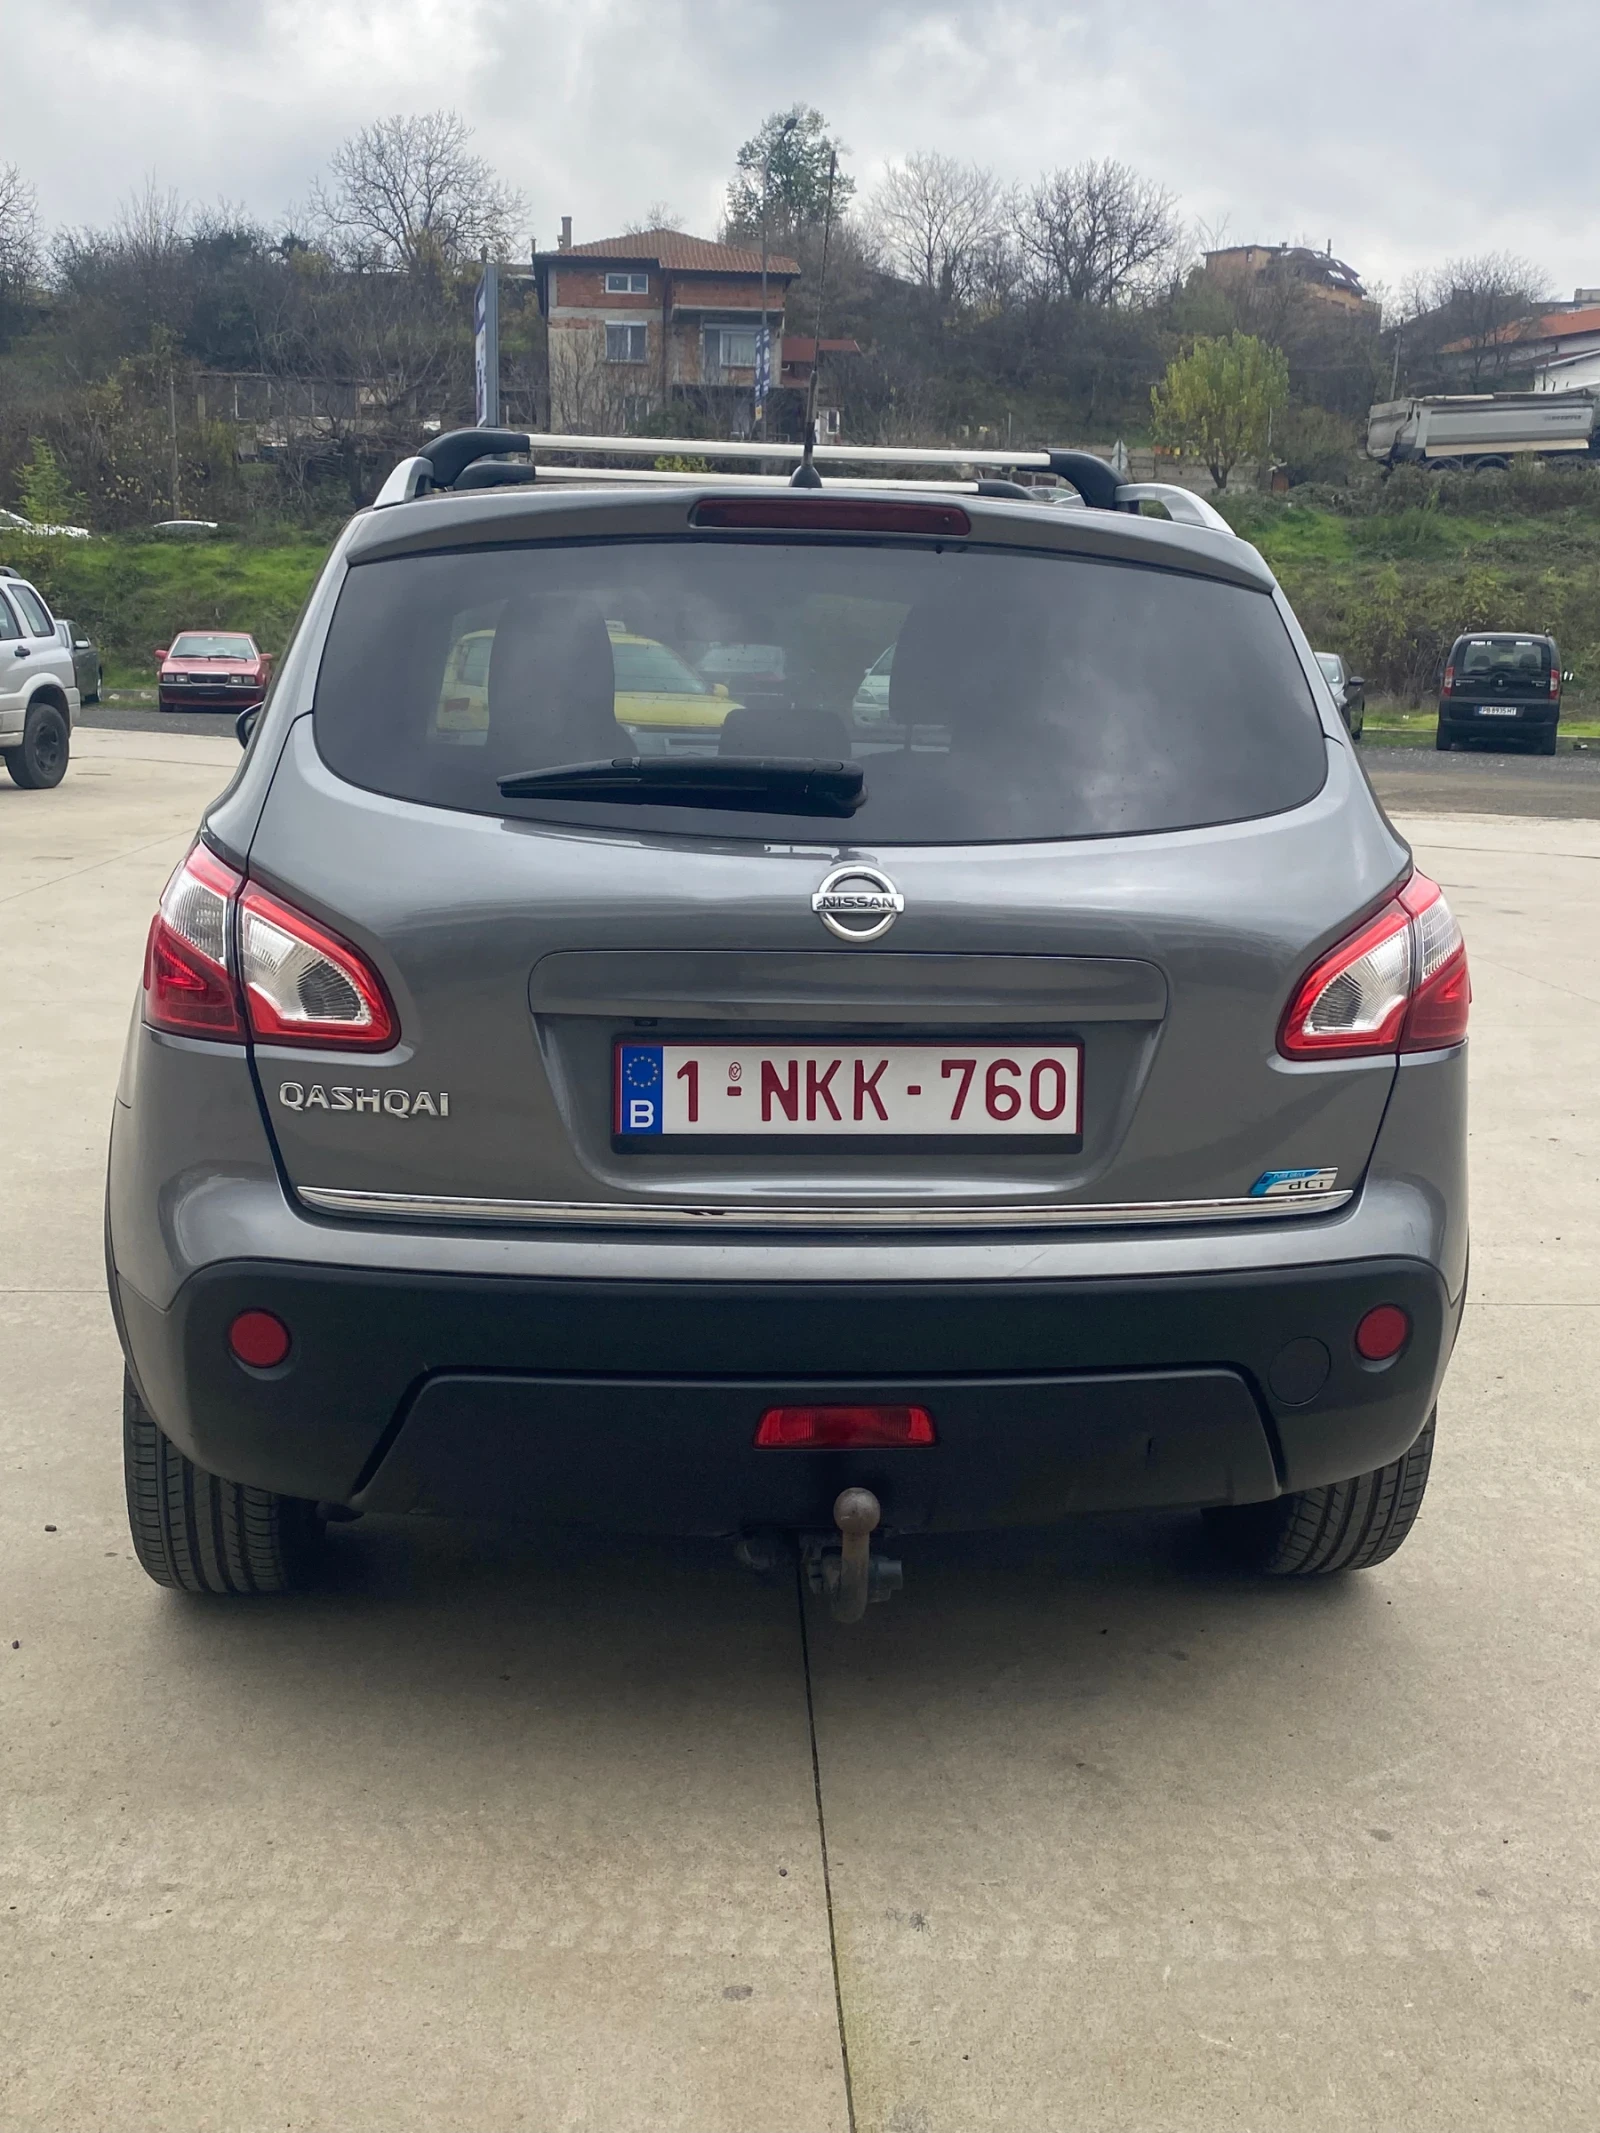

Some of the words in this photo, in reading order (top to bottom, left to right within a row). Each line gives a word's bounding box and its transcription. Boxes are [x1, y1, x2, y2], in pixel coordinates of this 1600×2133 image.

[820, 896, 896, 909] NISSAN
[279, 1081, 449, 1118] QASHQAI
[629, 1099, 654, 1128] B
[1288, 1180, 1324, 1190] dCi
